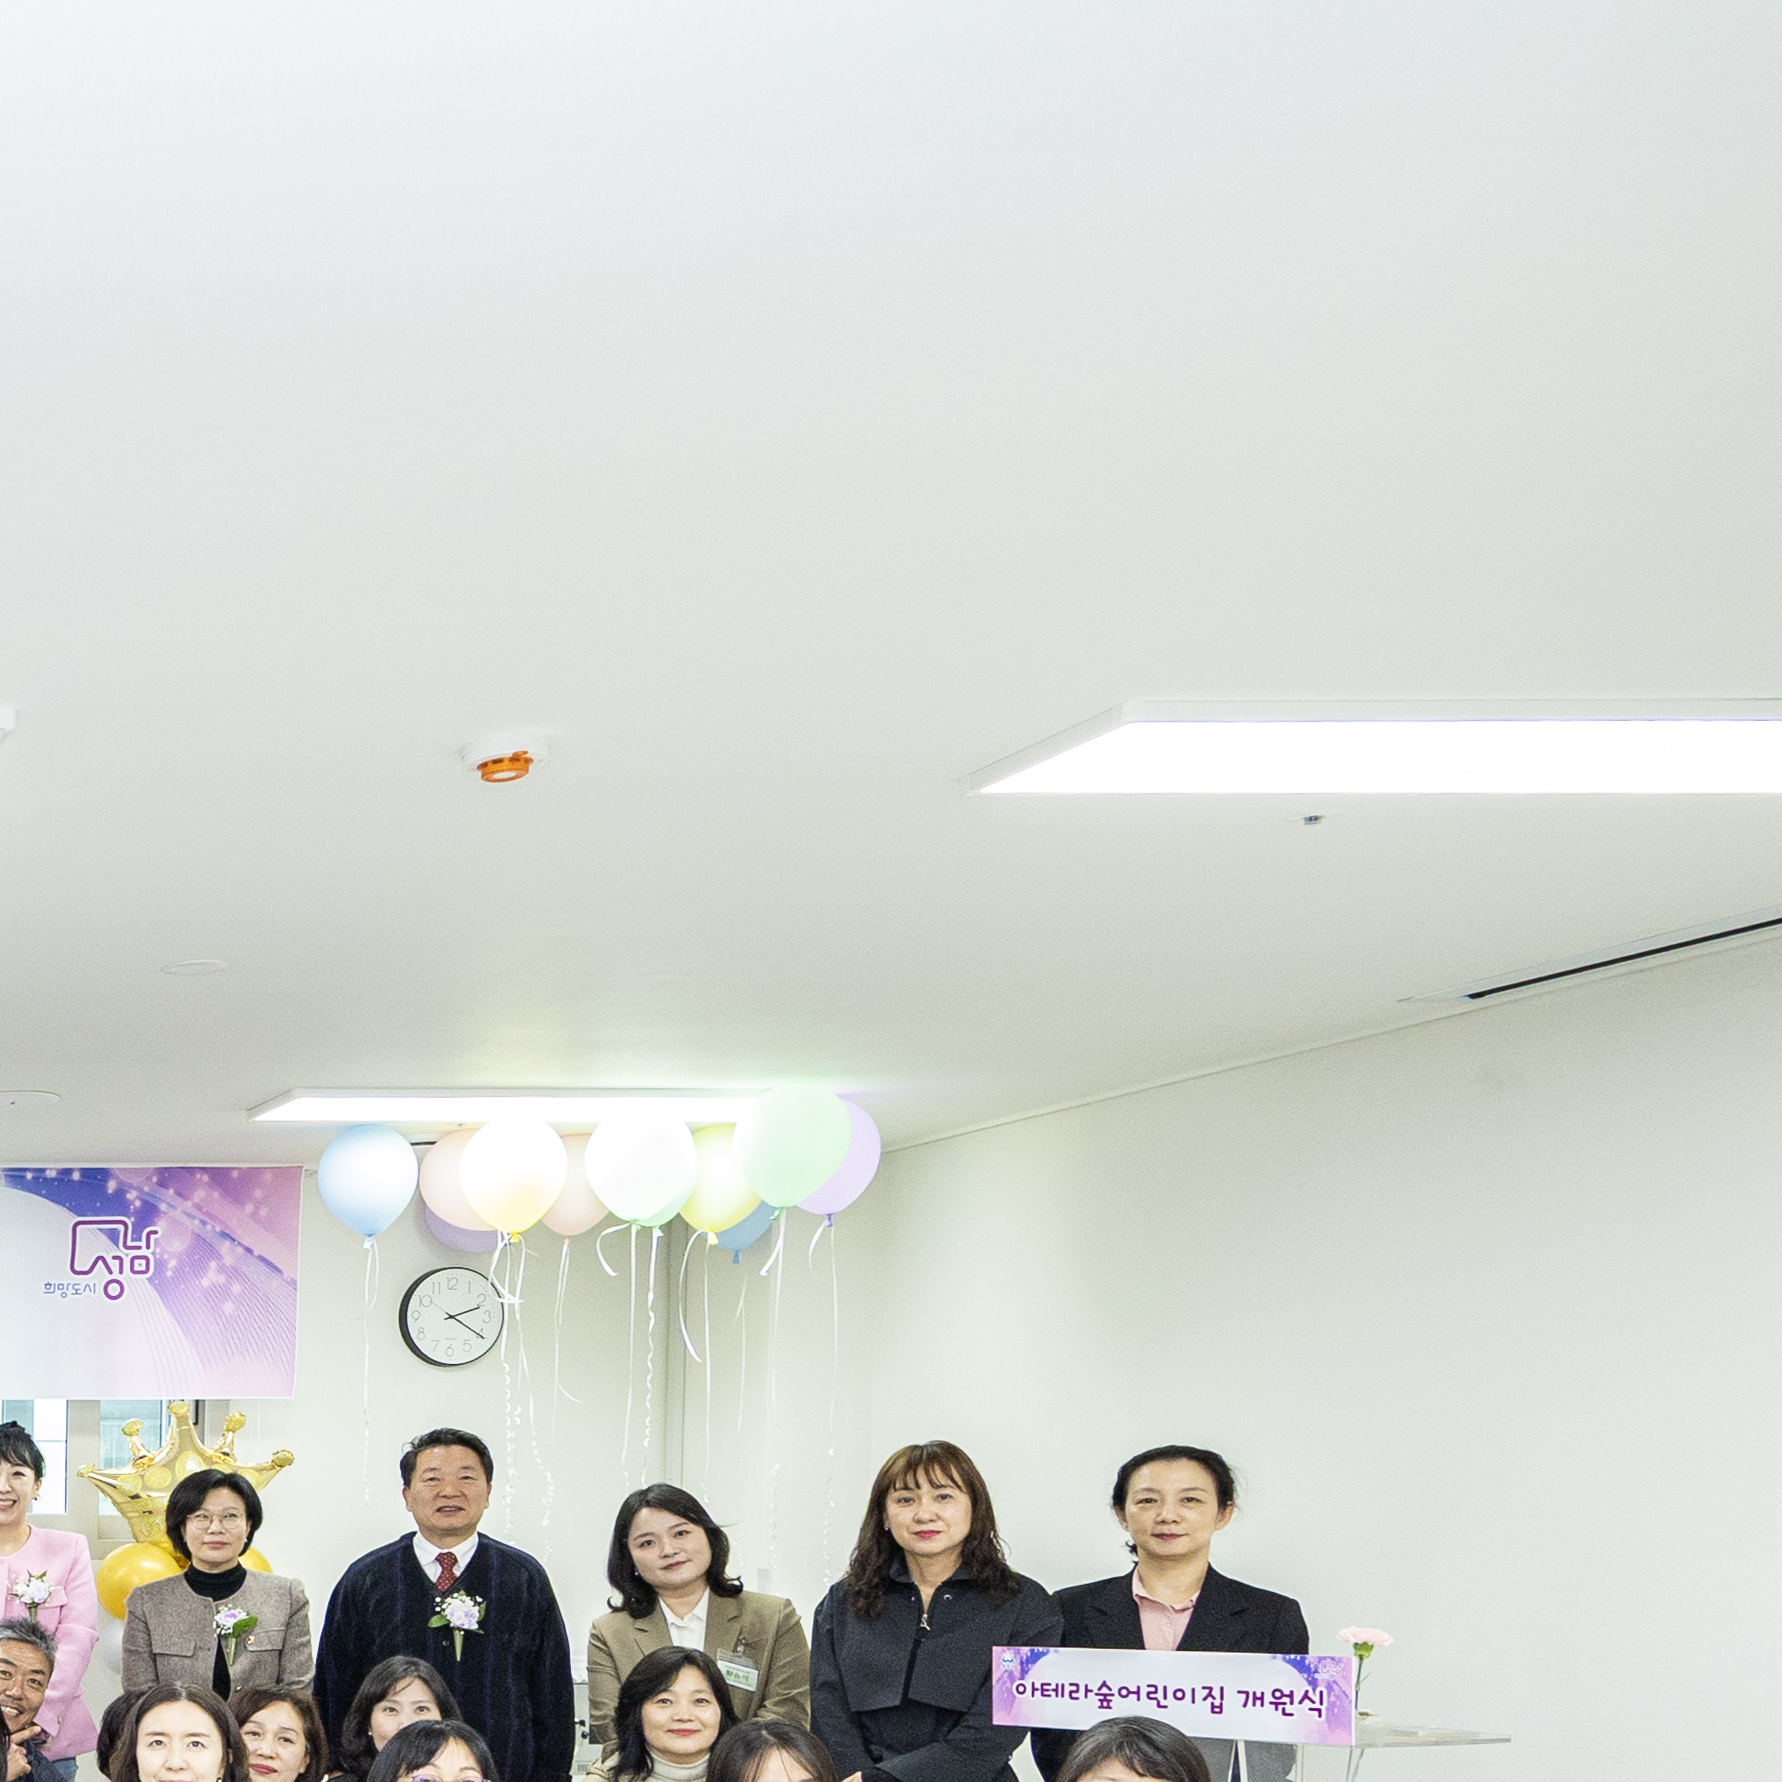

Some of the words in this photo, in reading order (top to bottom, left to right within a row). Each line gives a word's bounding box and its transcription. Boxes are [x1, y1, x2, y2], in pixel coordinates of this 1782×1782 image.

[43, 1280, 97, 1299] 희망도시
[1015, 1680, 1224, 1715] 아테라숲어린이집
[1237, 1687, 1324, 1719] 개원식
